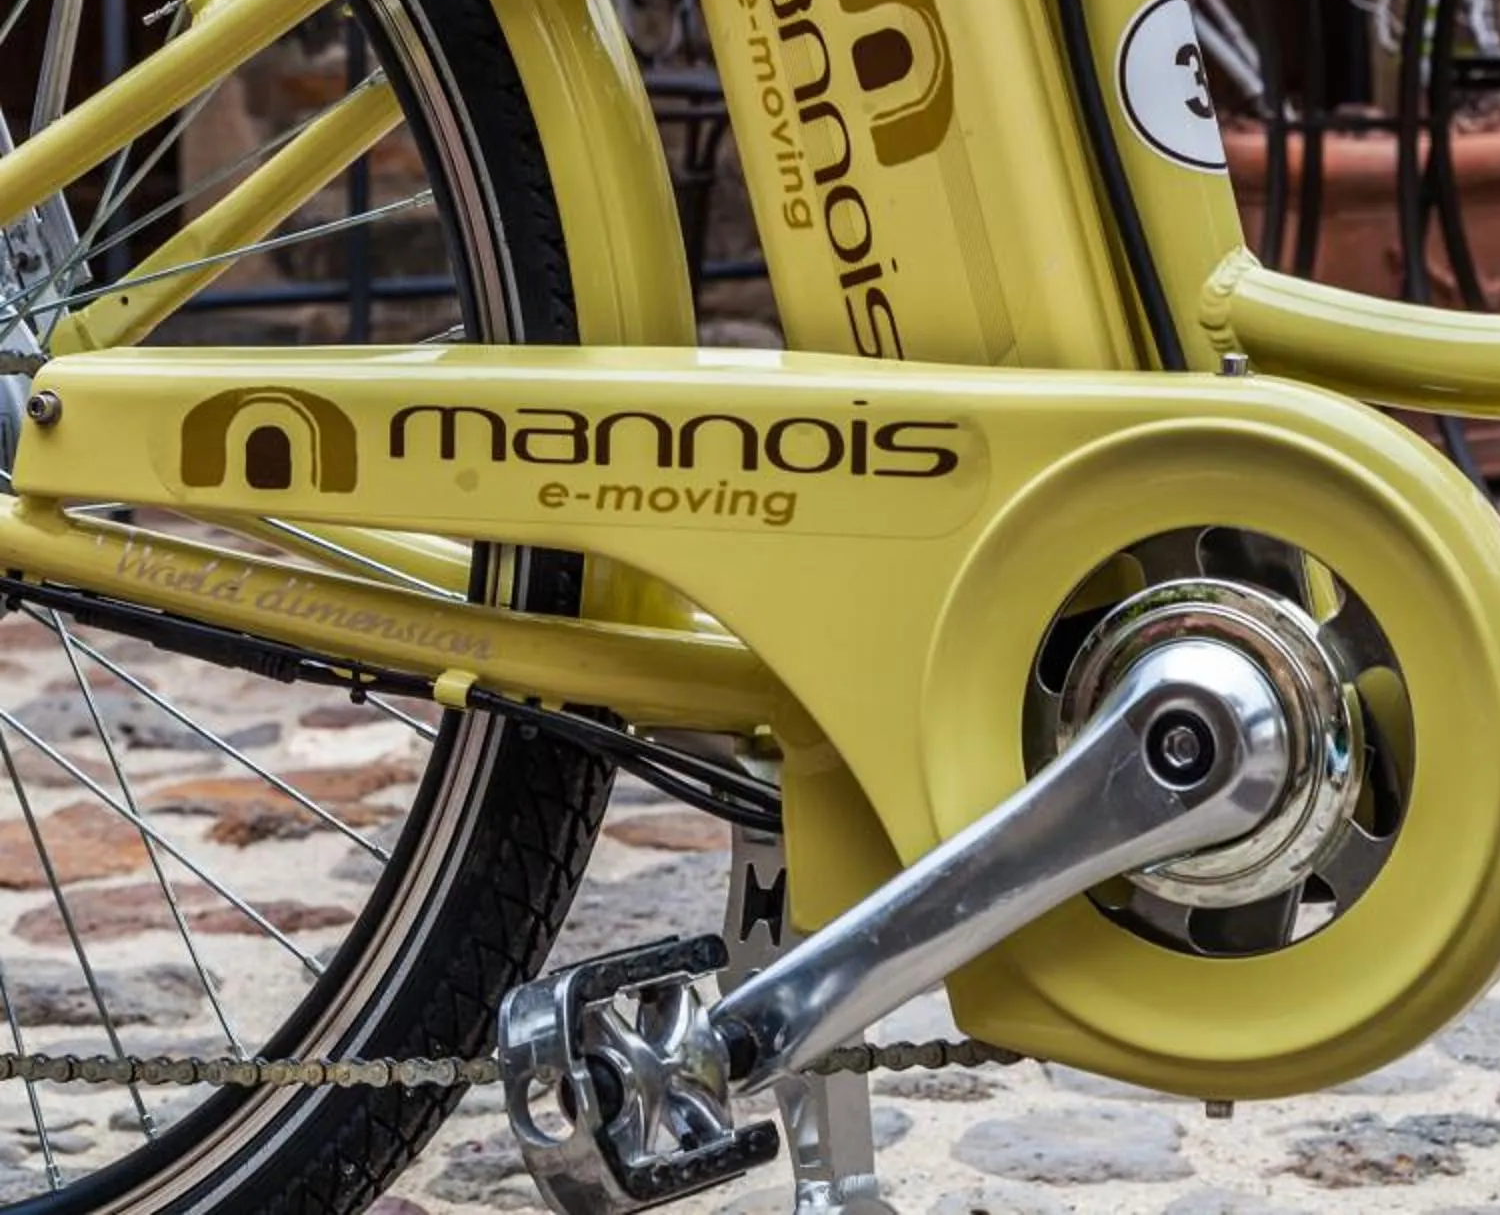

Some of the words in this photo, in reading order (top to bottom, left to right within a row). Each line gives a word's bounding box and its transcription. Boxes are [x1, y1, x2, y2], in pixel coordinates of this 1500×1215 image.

[389, 400, 959, 478] mannois
[537, 479, 798, 527] e-moving
[255, 576, 494, 661] dimension
